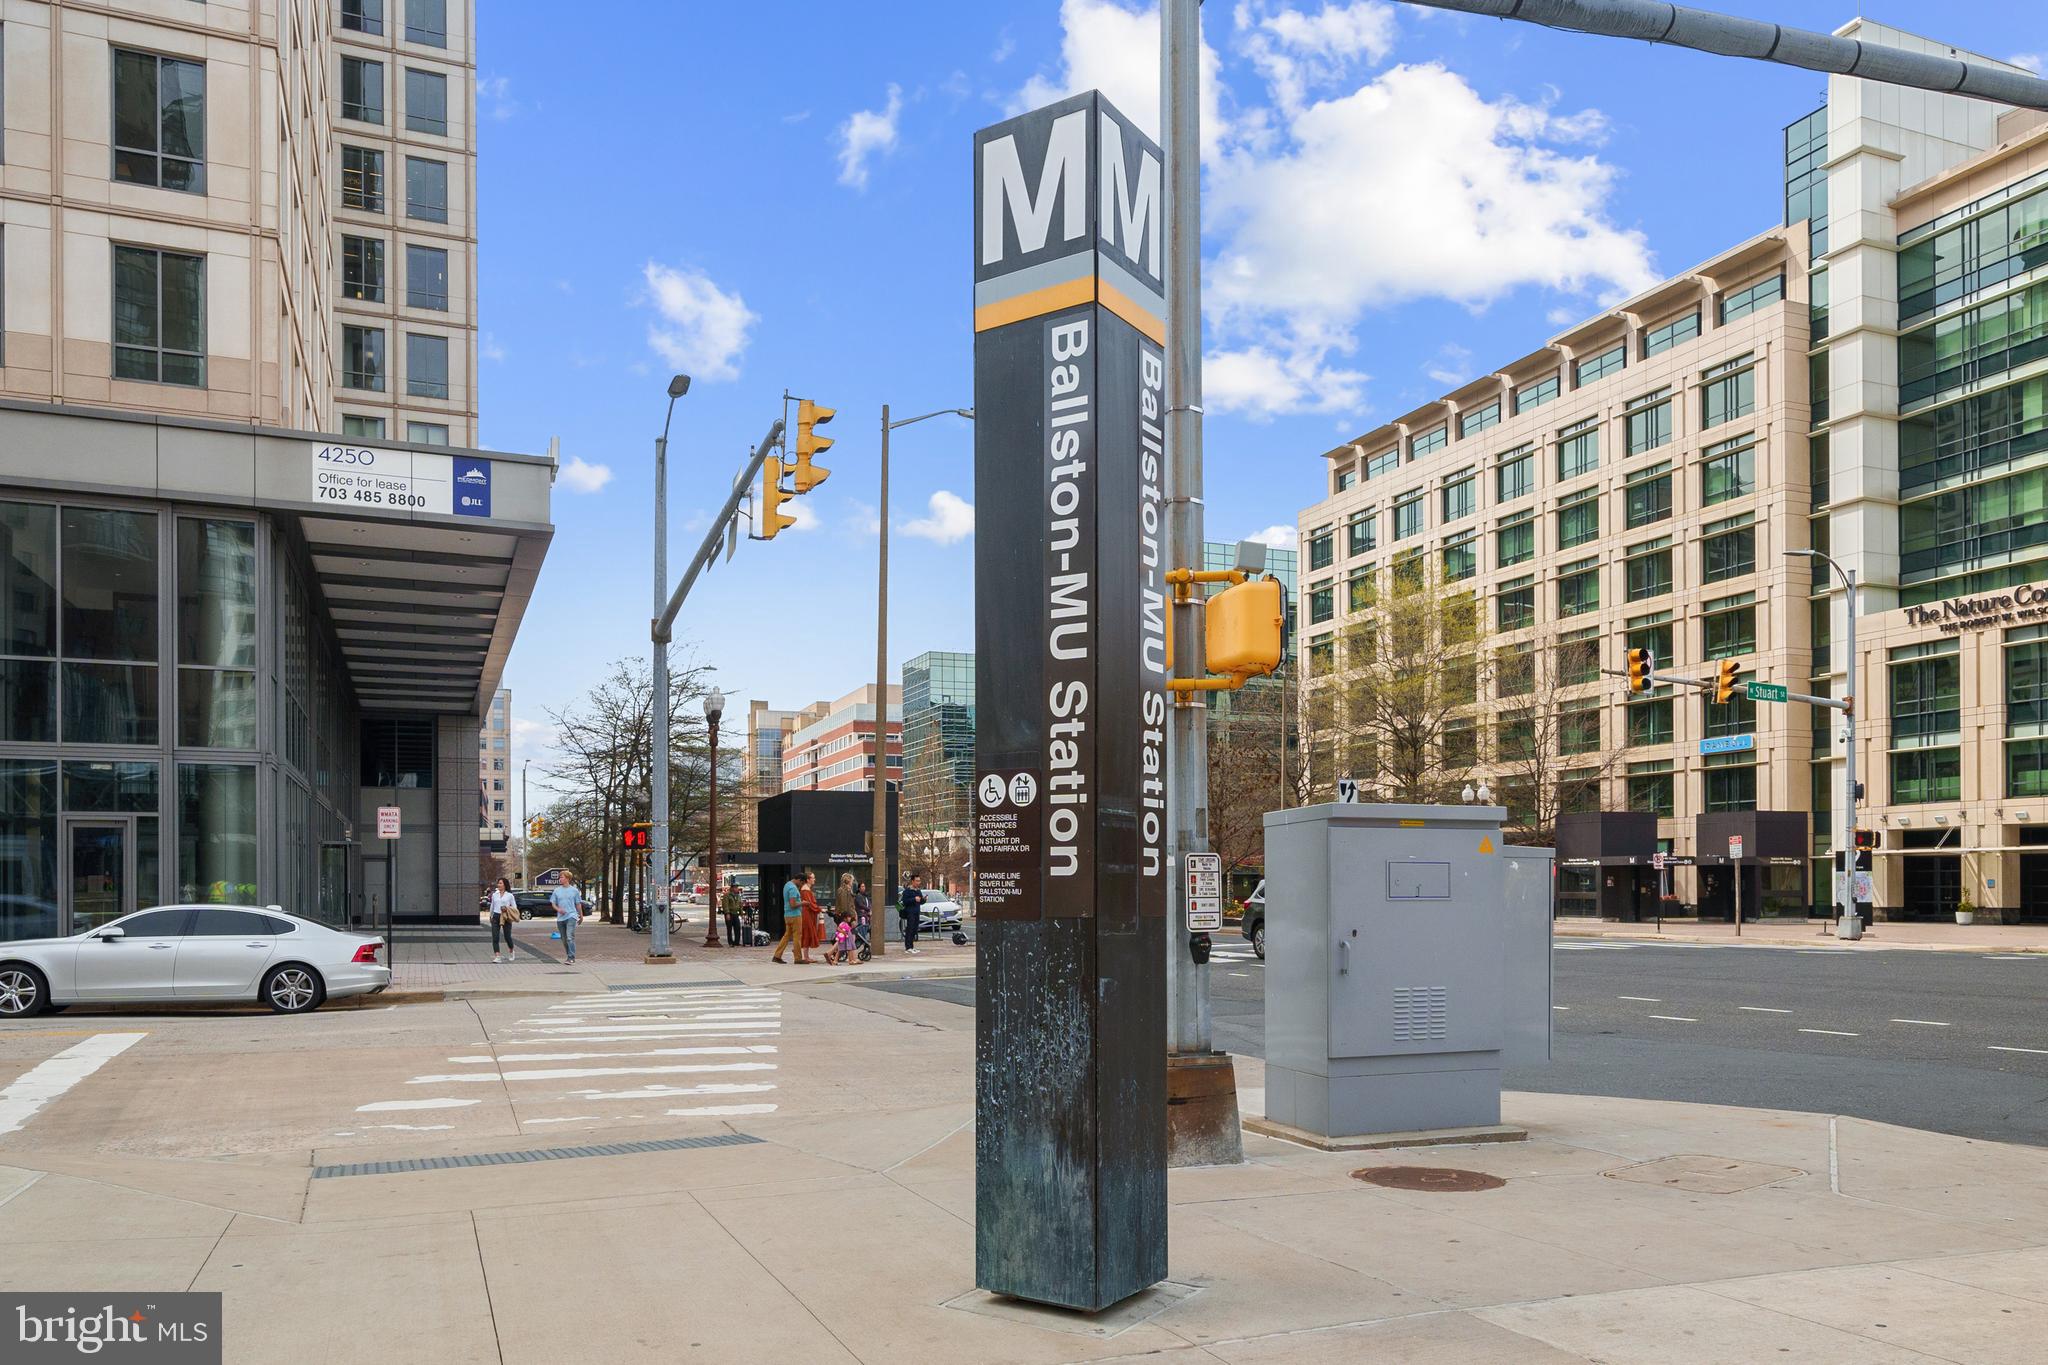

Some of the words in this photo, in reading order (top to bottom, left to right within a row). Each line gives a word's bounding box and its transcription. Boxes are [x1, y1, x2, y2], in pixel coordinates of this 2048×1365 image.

[983, 109, 1086, 266] M
[1101, 110, 1160, 282] M
[318, 447, 374, 465] 4250
[319, 472, 353, 486] Office
[357, 477, 372, 488] for
[376, 479, 407, 491] lease
[1050, 319, 1089, 661] Ballston-MU
[319, 486, 347, 500] 703
[354, 490, 382, 503] 485
[388, 493, 425, 508] 8800
[1142, 349, 1164, 674] Ballston-MU
[1904, 604, 1940, 625] The
[1942, 595, 2012, 618] Nature
[1940, 622, 1959, 632] THE
[1960, 614, 1999, 629] ROBERT
[1755, 686, 1778, 699] Stuart
[1049, 681, 1088, 877] Station
[1143, 691, 1164, 877] Station
[979, 821, 1017, 829] ENTRANCES
[980, 813, 1018, 821] ACCESSIBLE
[980, 829, 1006, 837] ACROSS
[985, 837, 1009, 845] STUART
[1020, 844, 1030, 852] DR
[979, 895, 1005, 903] STATION
